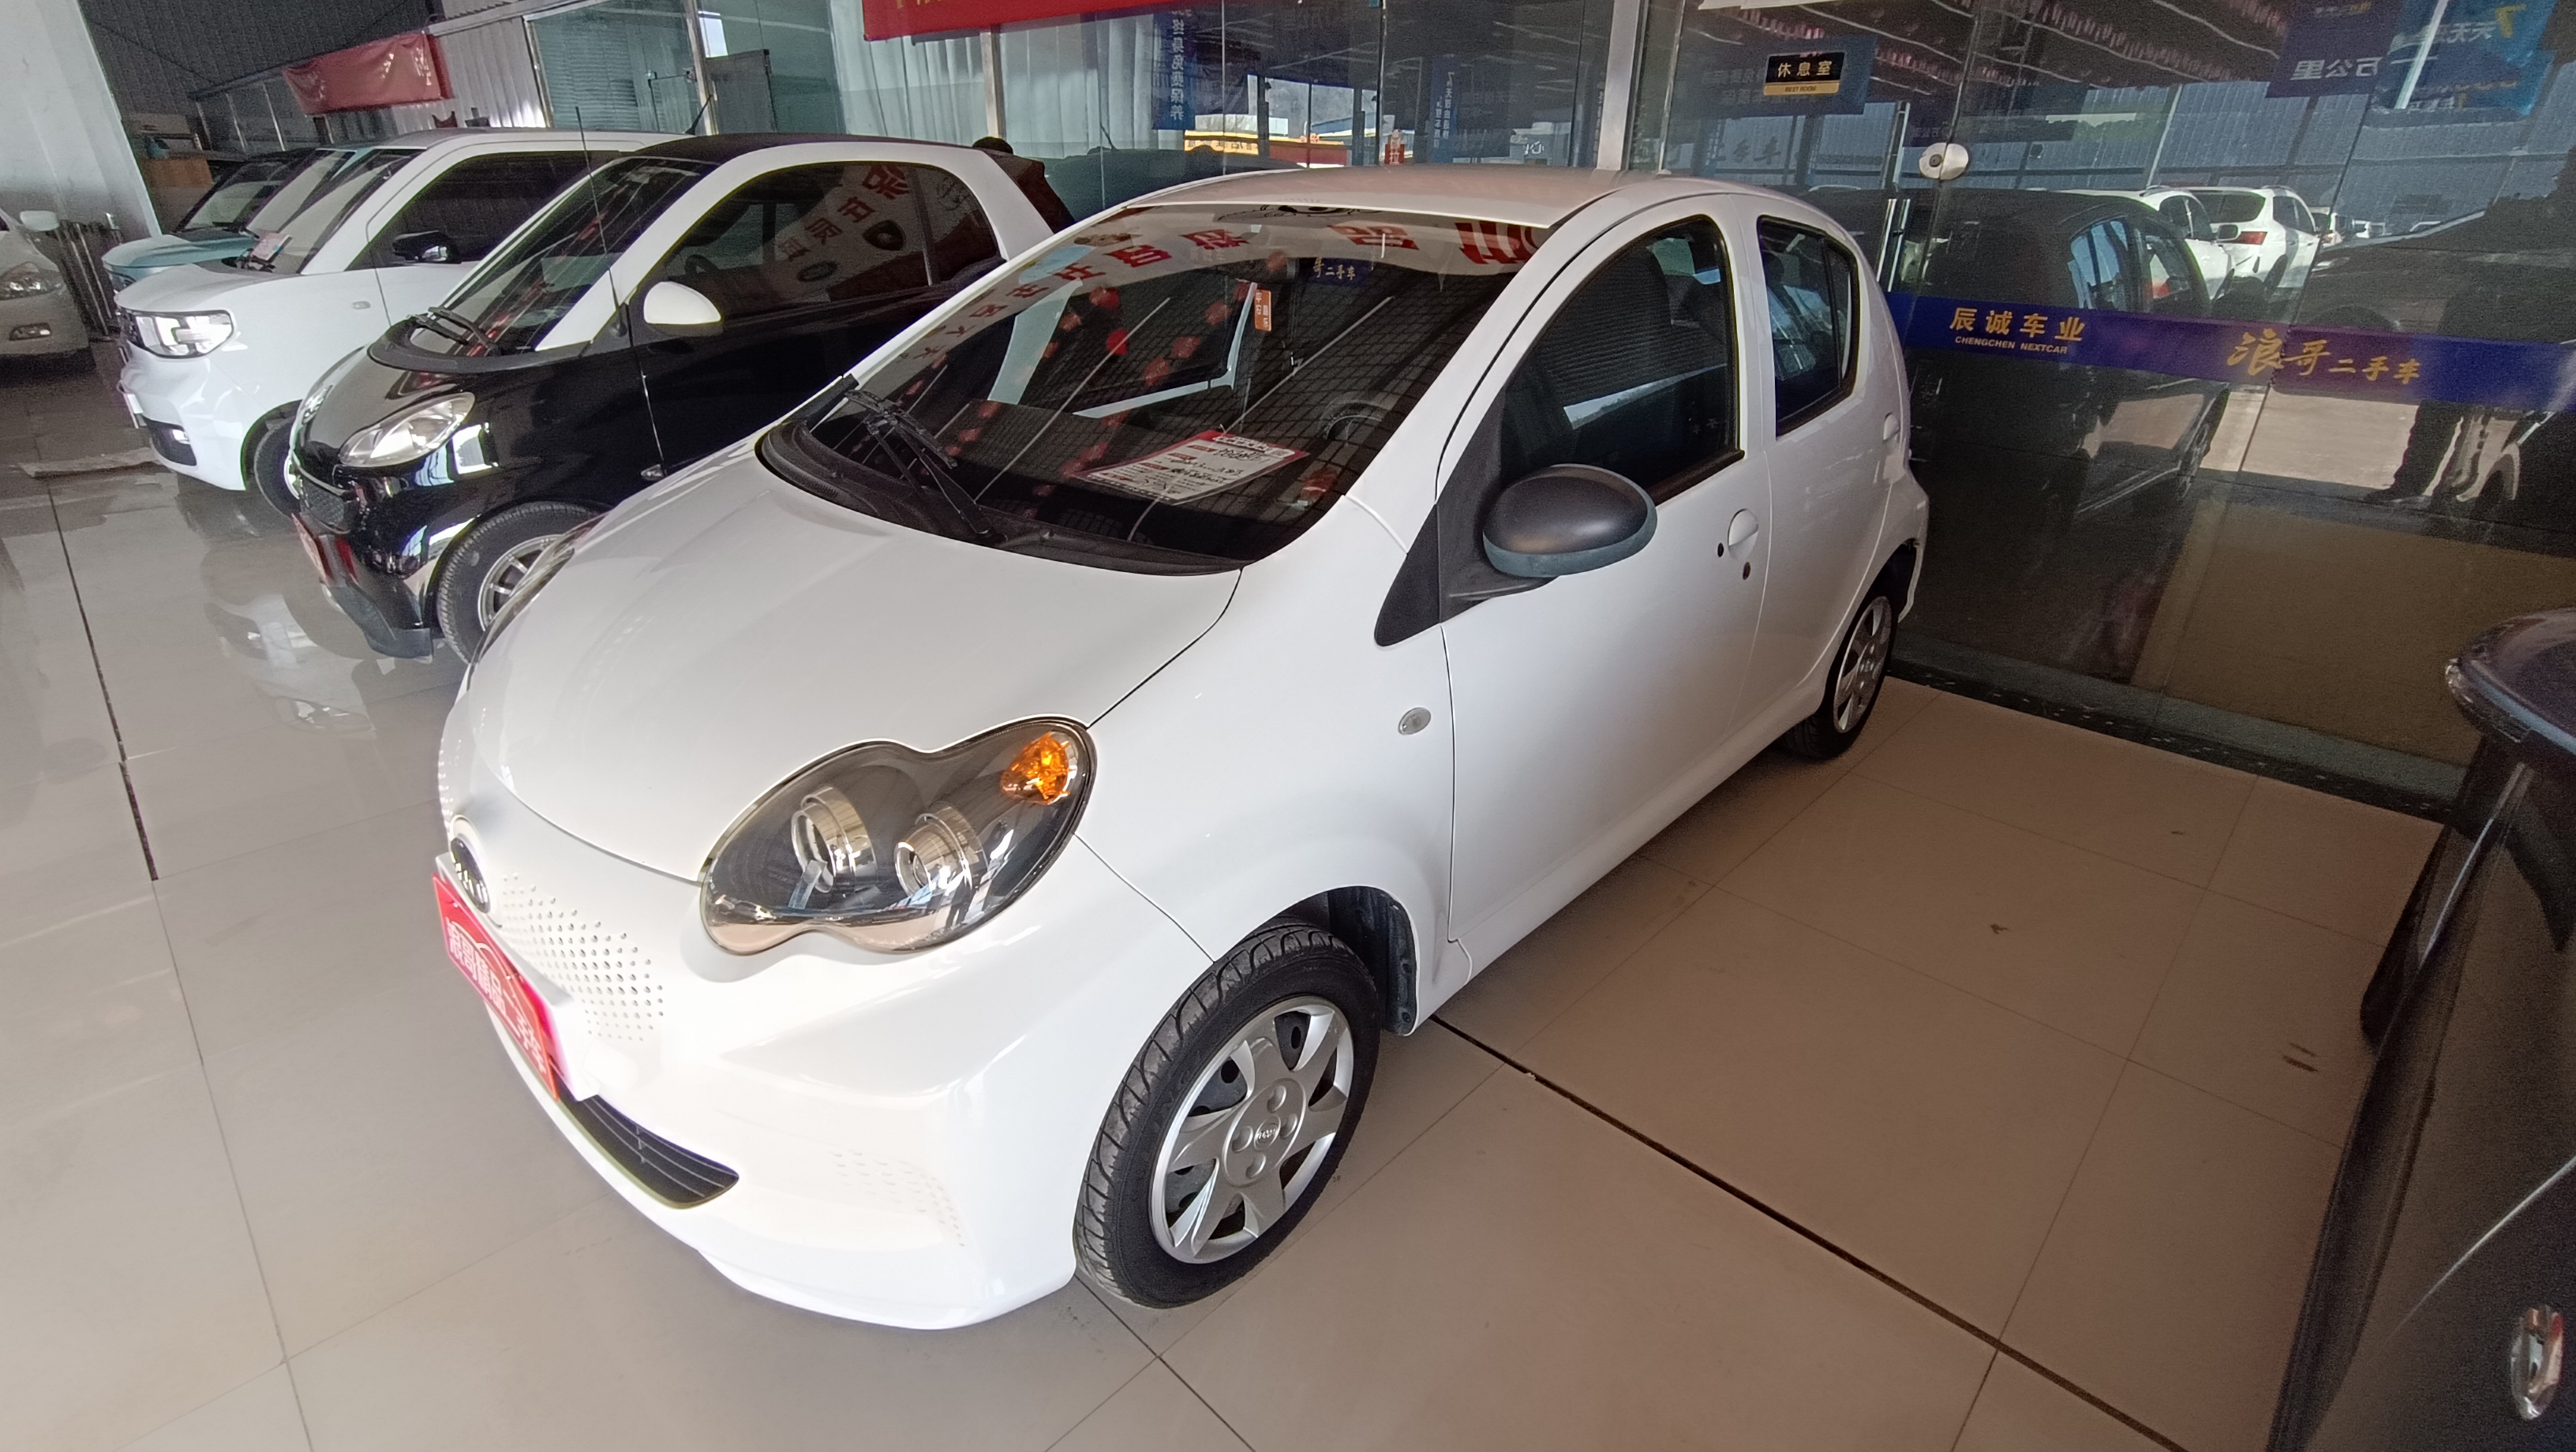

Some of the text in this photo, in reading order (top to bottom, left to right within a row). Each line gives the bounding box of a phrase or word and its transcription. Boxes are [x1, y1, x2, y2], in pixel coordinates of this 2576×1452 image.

[1777, 60, 1832, 78] 休息室
[1949, 307, 2086, 342] 辰诚车业
[1955, 335, 2068, 354] CHENGCHEN NEXTCAR
[2226, 327, 2421, 384] 浪哥二手车
